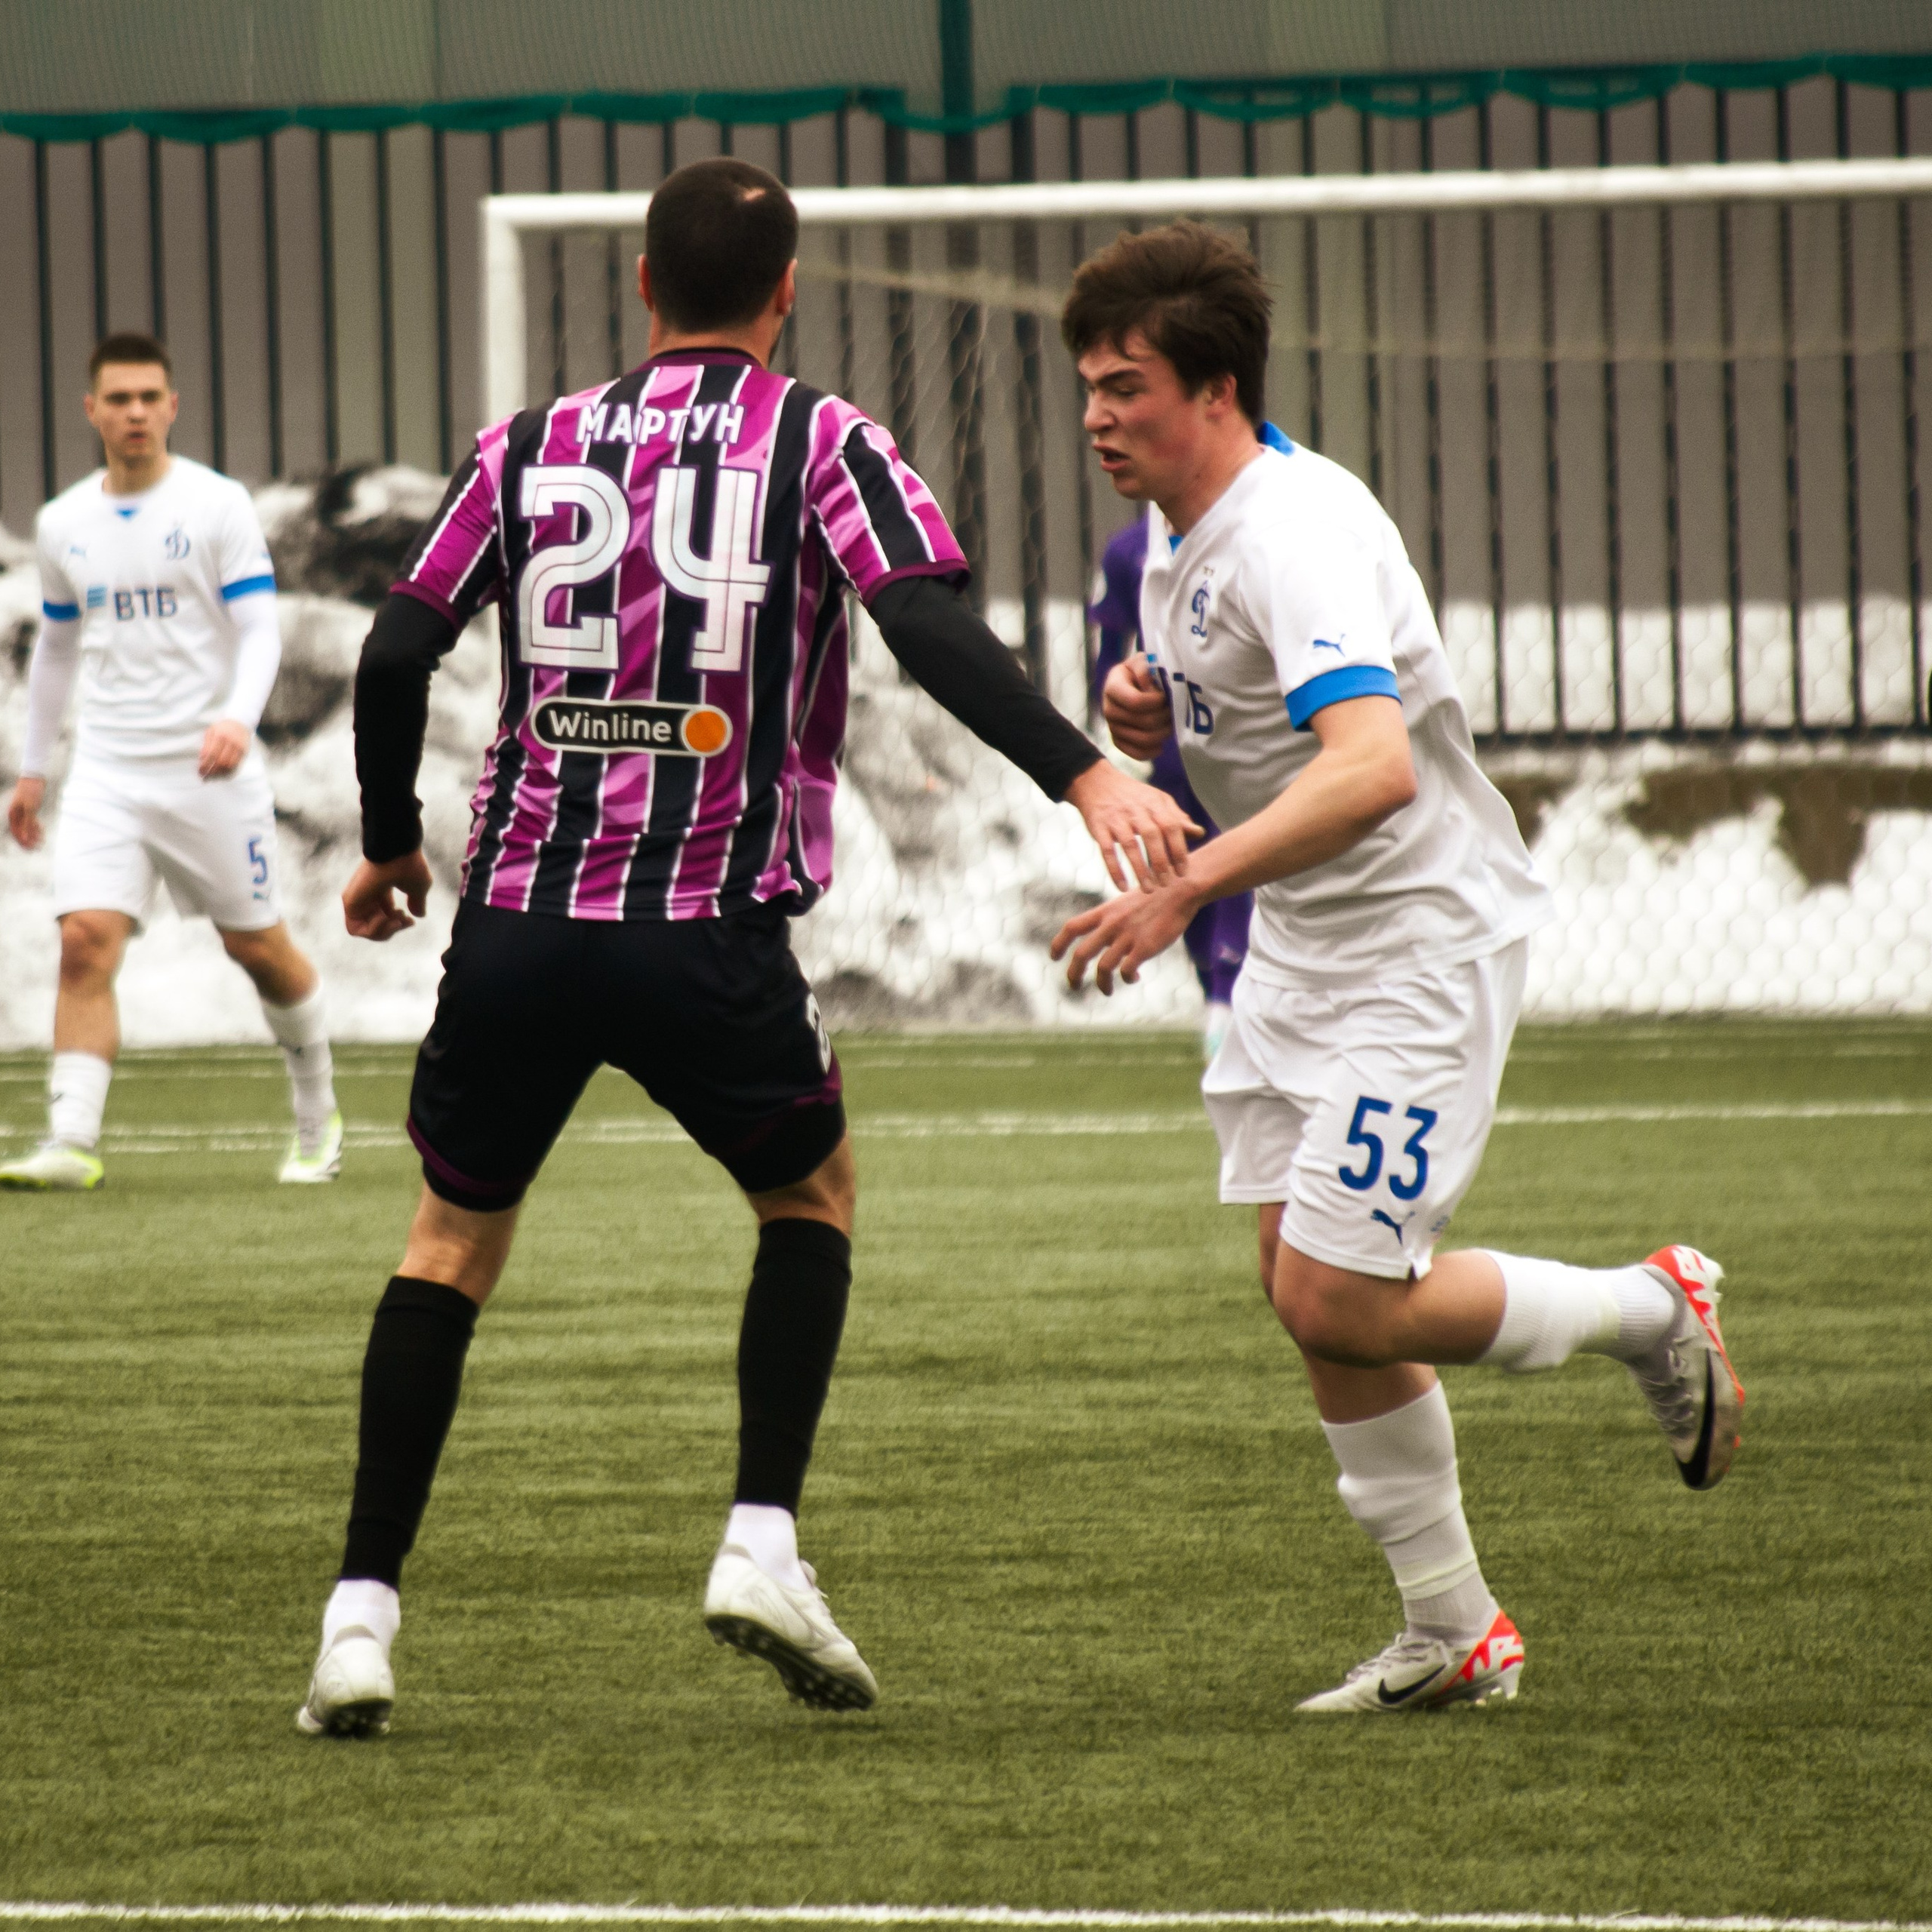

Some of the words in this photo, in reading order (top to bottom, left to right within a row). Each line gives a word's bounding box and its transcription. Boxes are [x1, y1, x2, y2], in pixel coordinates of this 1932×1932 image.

[575, 403, 744, 444] МАРТУН
[518, 466, 771, 671] 24
[115, 585, 178, 620] ВТБ
[549, 710, 673, 743] Winline
[248, 834, 268, 884] 5
[1339, 1095, 1438, 1201] 53
